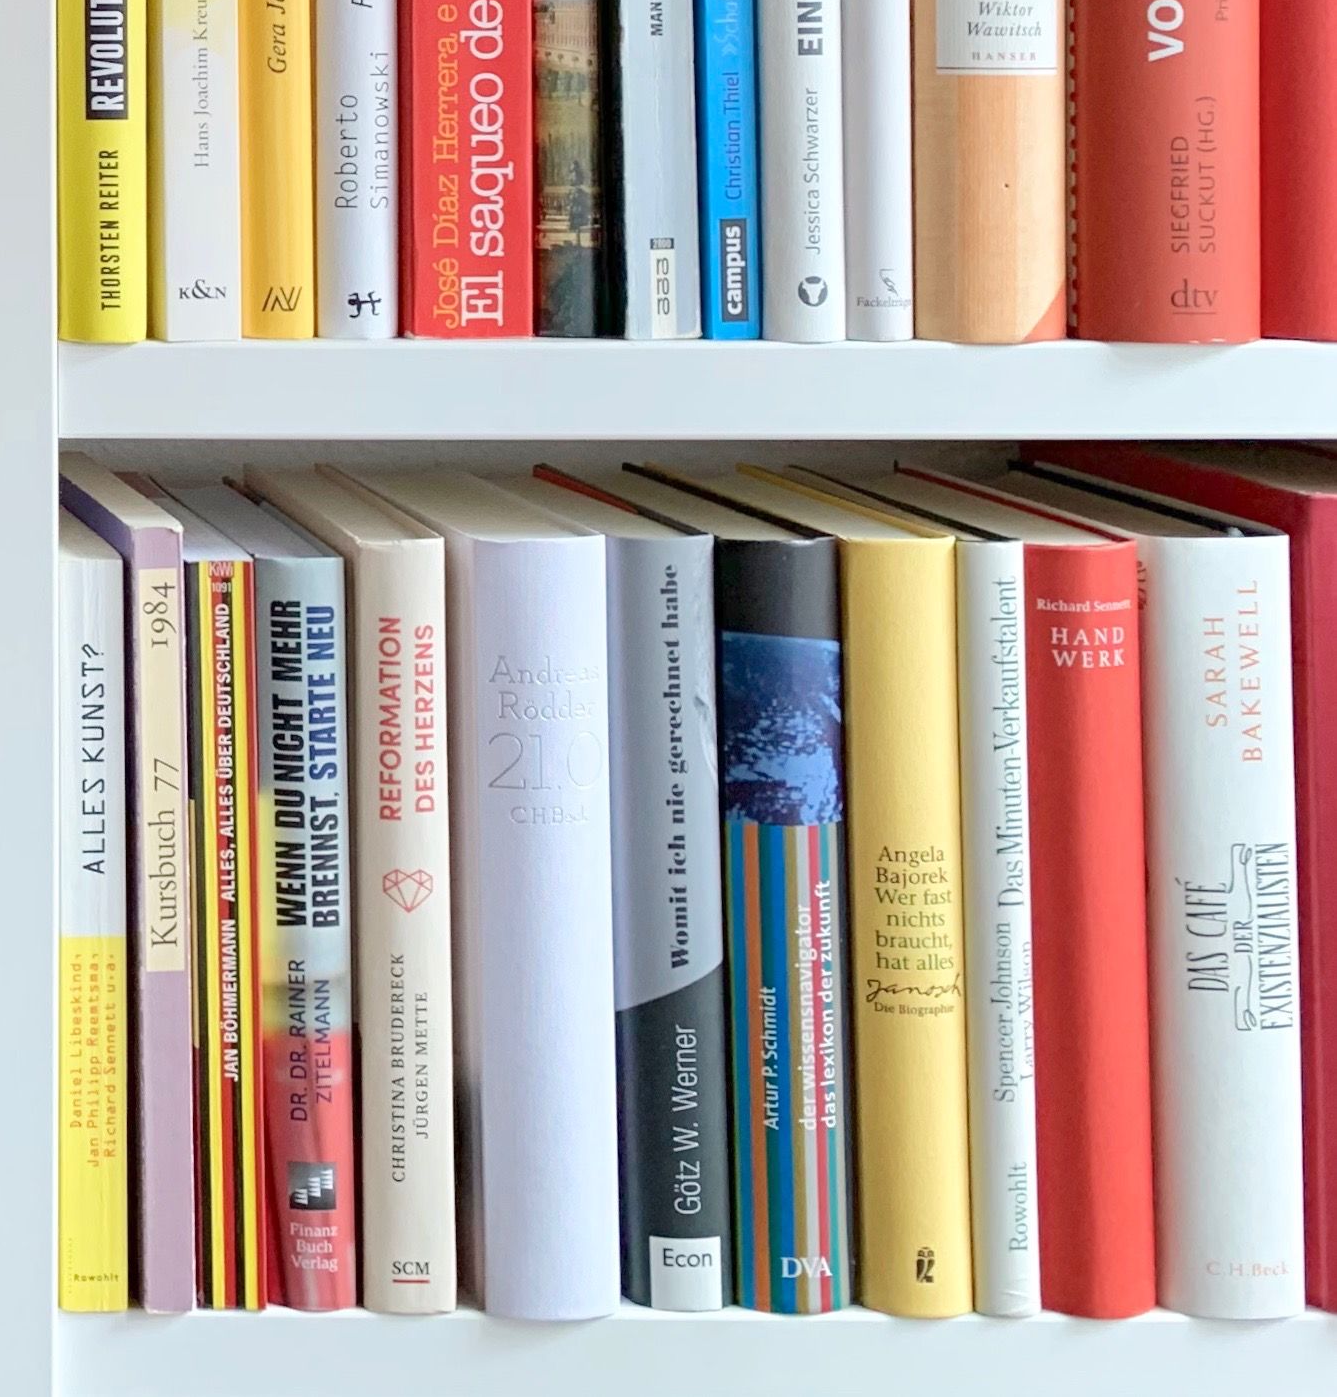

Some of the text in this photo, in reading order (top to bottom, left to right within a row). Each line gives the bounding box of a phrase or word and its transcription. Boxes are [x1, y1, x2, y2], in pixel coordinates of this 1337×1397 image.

[460, 0, 503, 59] de
[99, 149, 119, 312] THORSTEN REITER
[456, 73, 513, 256] saqueo
[456, 271, 503, 326] El
[725, 225, 744, 316] campus
[1050, 628, 1124, 645] HAND
[1051, 650, 1124, 668] WERK
[81, 643, 106, 876] ALLES KUNST?
[146, 582, 179, 949] Kursbuch 77 1984
[270, 601, 309, 926] WENN DU NICHT MEHR
[306, 606, 339, 927] BRENNST, STARTE NEU
[379, 617, 401, 820] REFORMATION
[414, 625, 434, 812] DES HERZENS
[675, 1024, 699, 1215] Götz W. Werner
[392, 1261, 430, 1275] SCM
[662, 1248, 713, 1268] Econ
[780, 1256, 831, 1278] DVA
